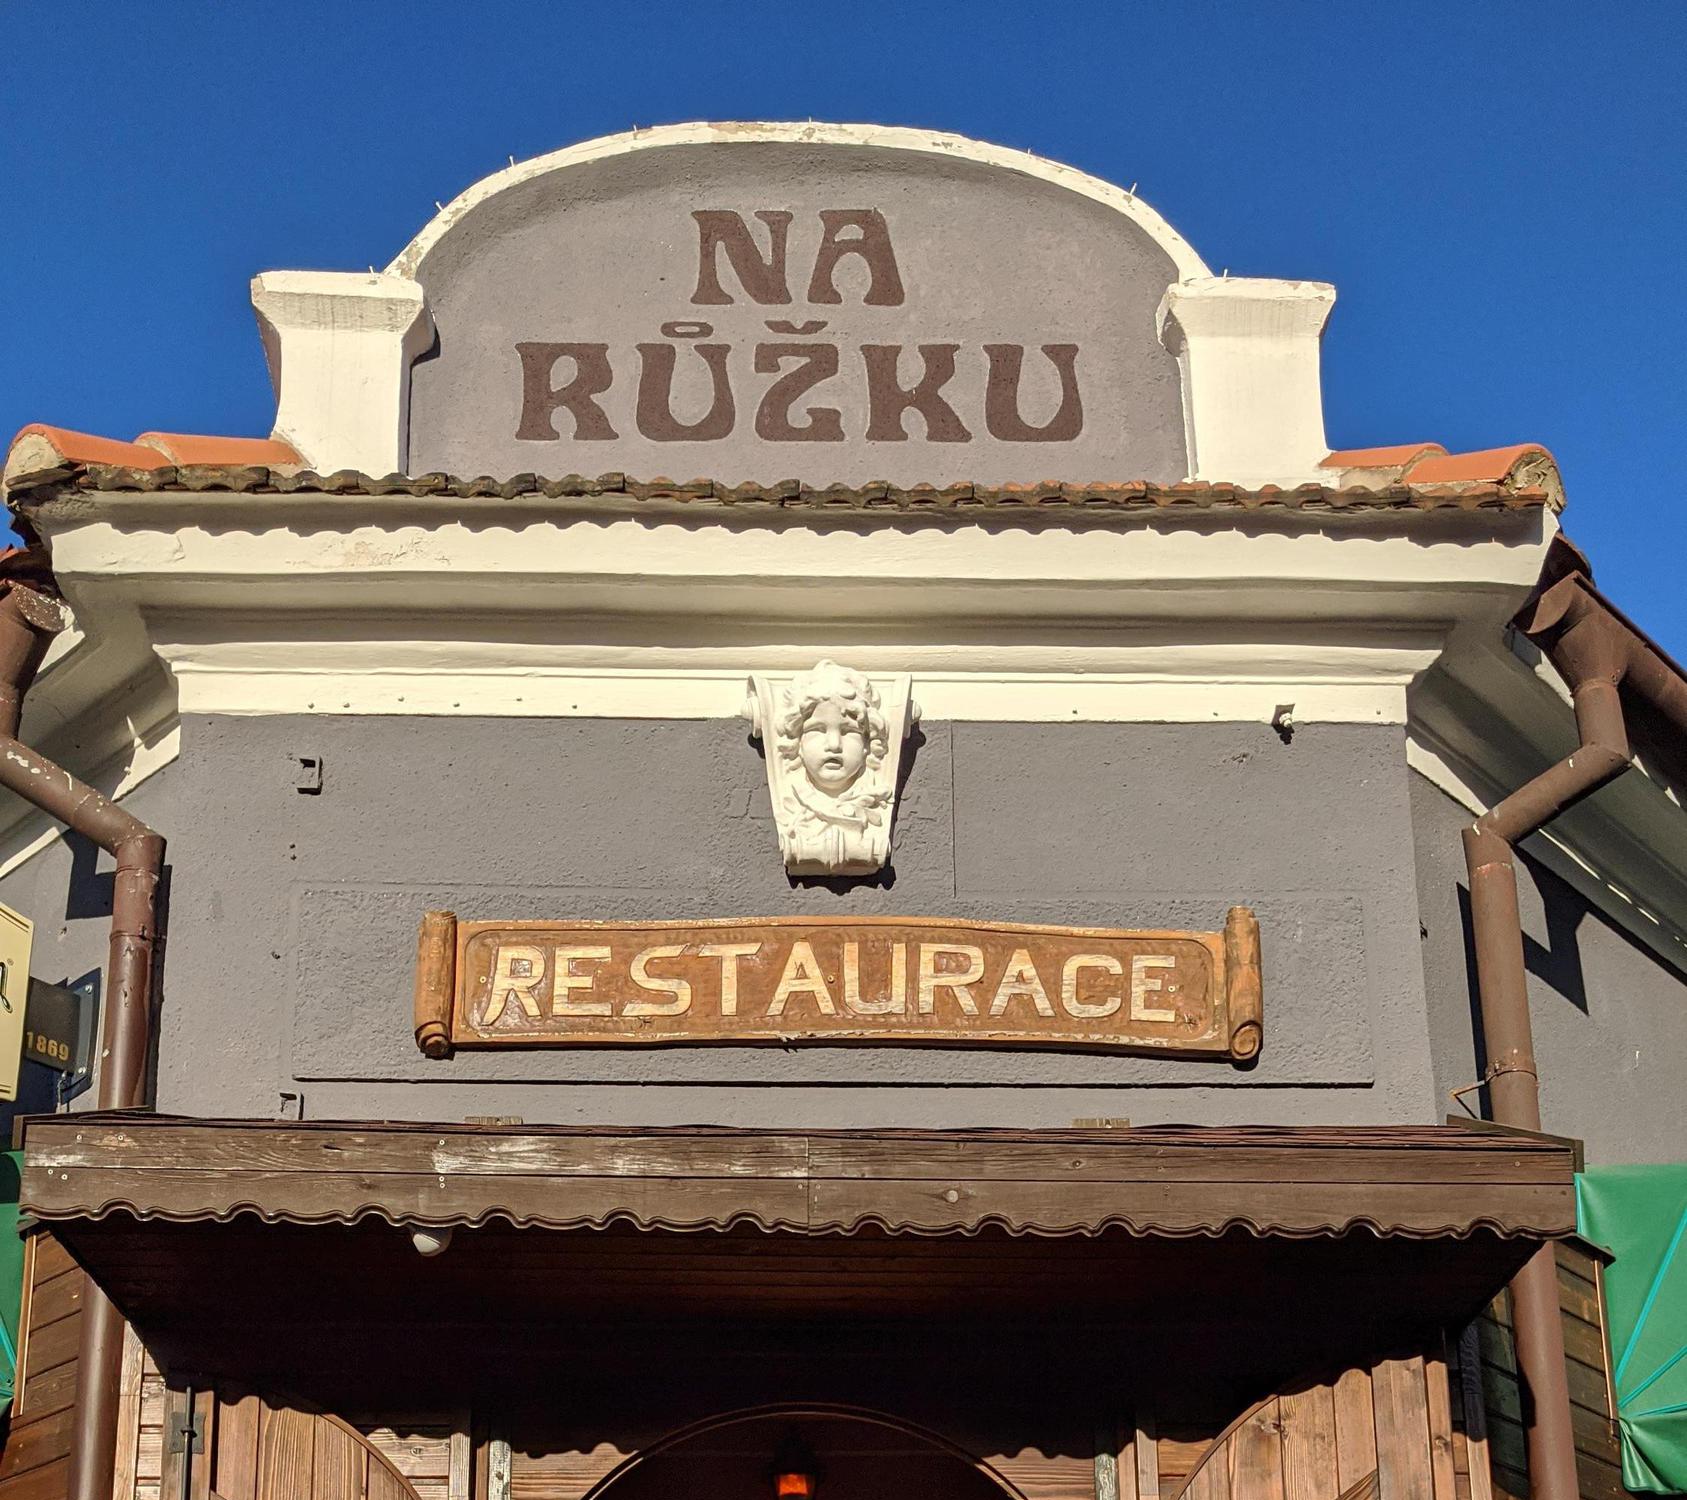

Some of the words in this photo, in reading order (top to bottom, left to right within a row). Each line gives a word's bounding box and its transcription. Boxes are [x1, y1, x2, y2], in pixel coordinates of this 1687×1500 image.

[690, 208, 905, 306] NA
[515, 320, 1083, 443] RŮŽKU
[481, 940, 1177, 1026] RESTAURACE
[26, 1030, 70, 1062] 1869
